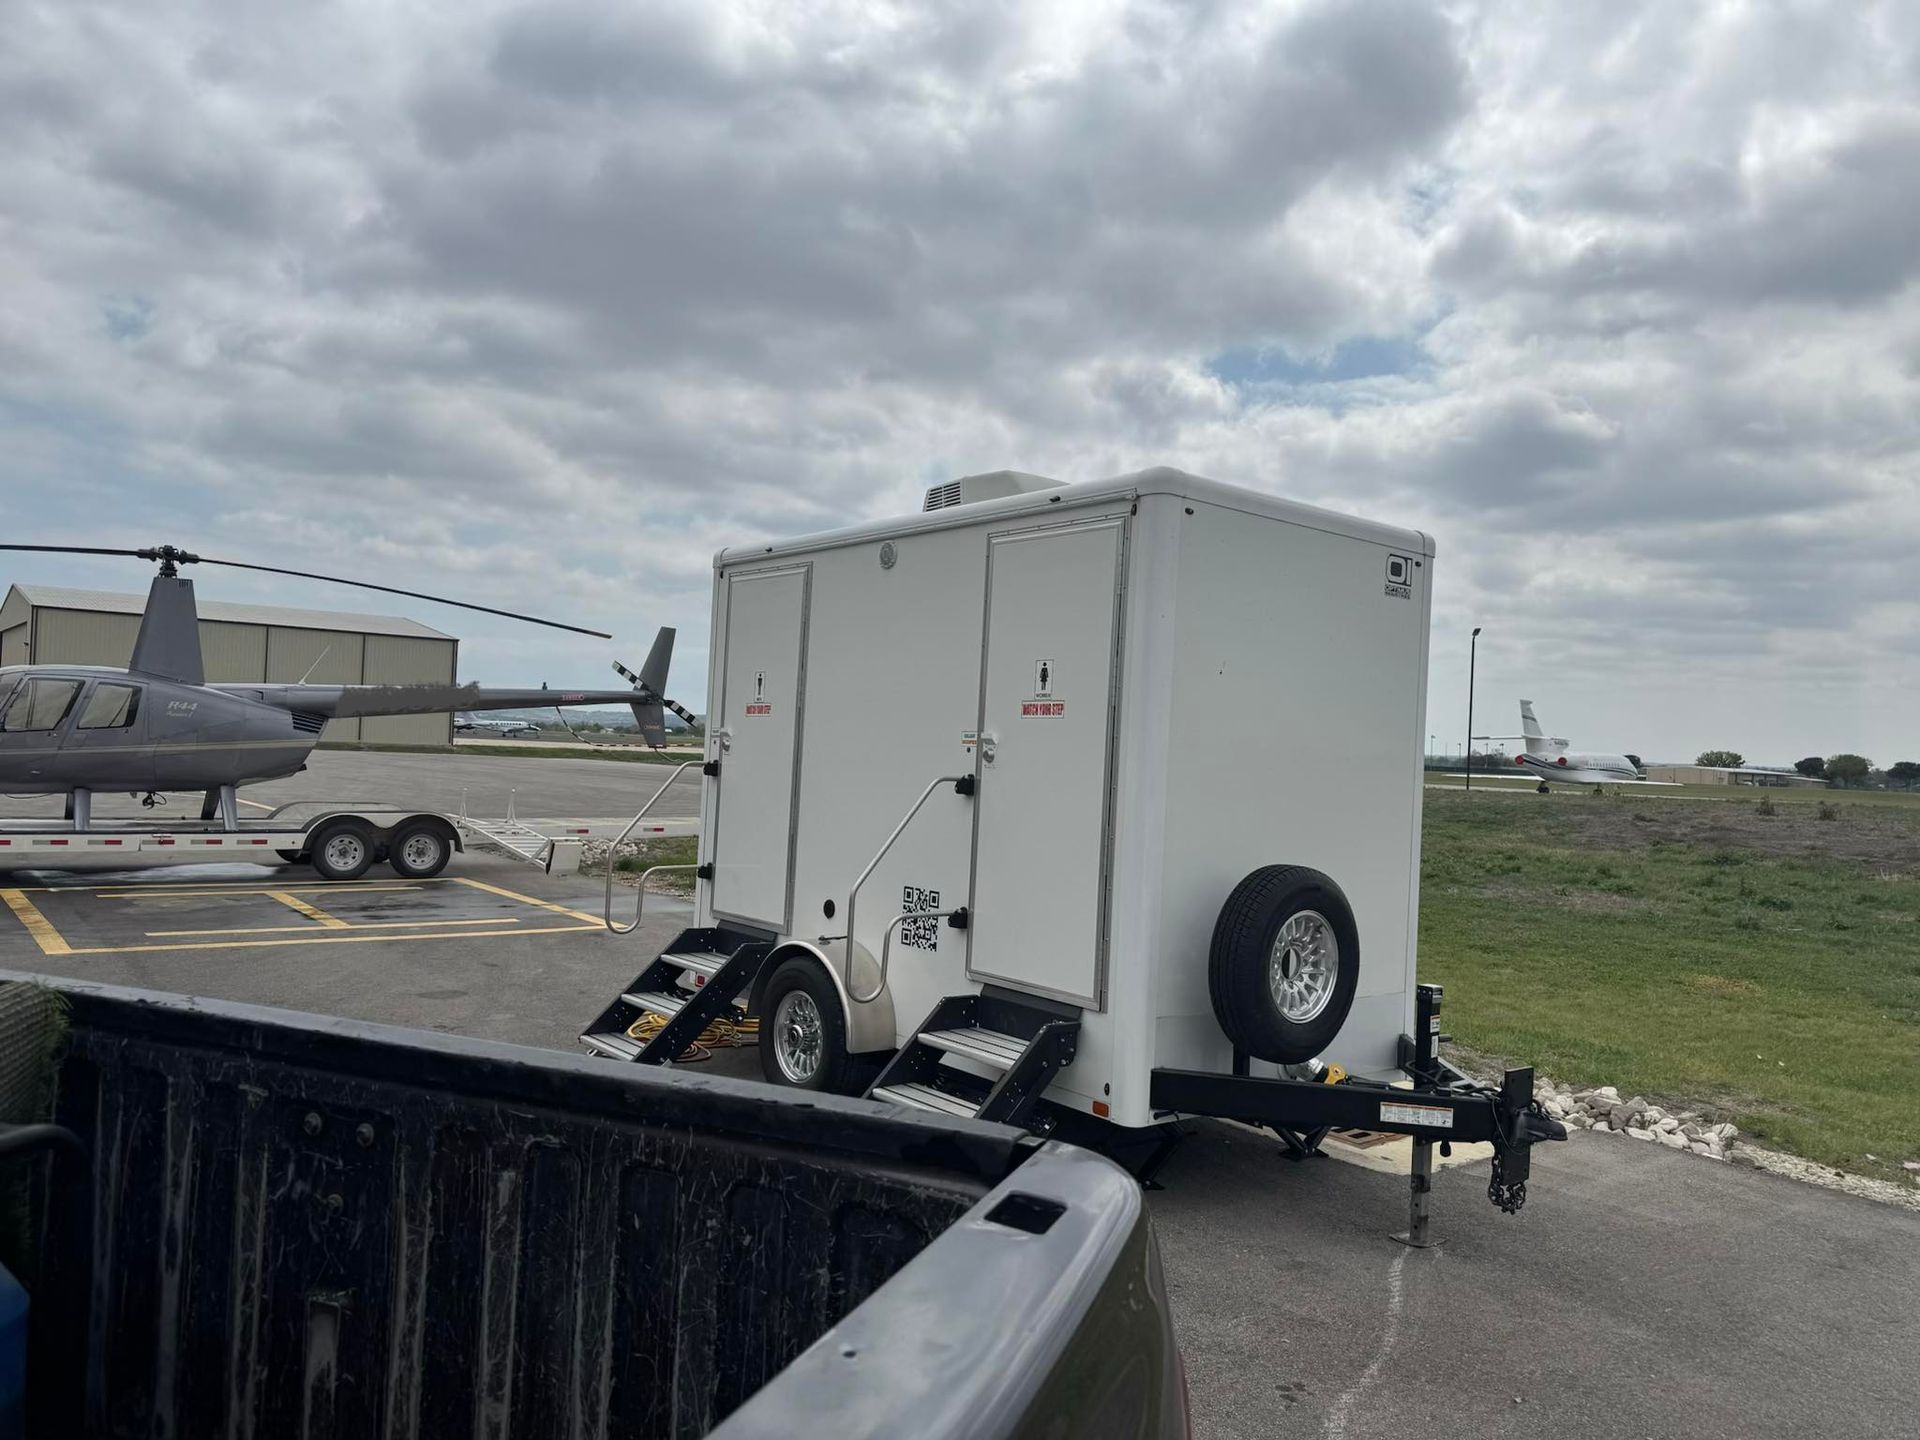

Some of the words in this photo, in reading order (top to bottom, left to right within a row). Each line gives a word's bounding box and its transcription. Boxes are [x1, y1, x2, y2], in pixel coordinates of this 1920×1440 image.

[168, 701, 199, 710] R44
[1023, 703, 1039, 716] WATCH
[1039, 703, 1052, 716] YOUR
[1052, 703, 1064, 716] STEP
